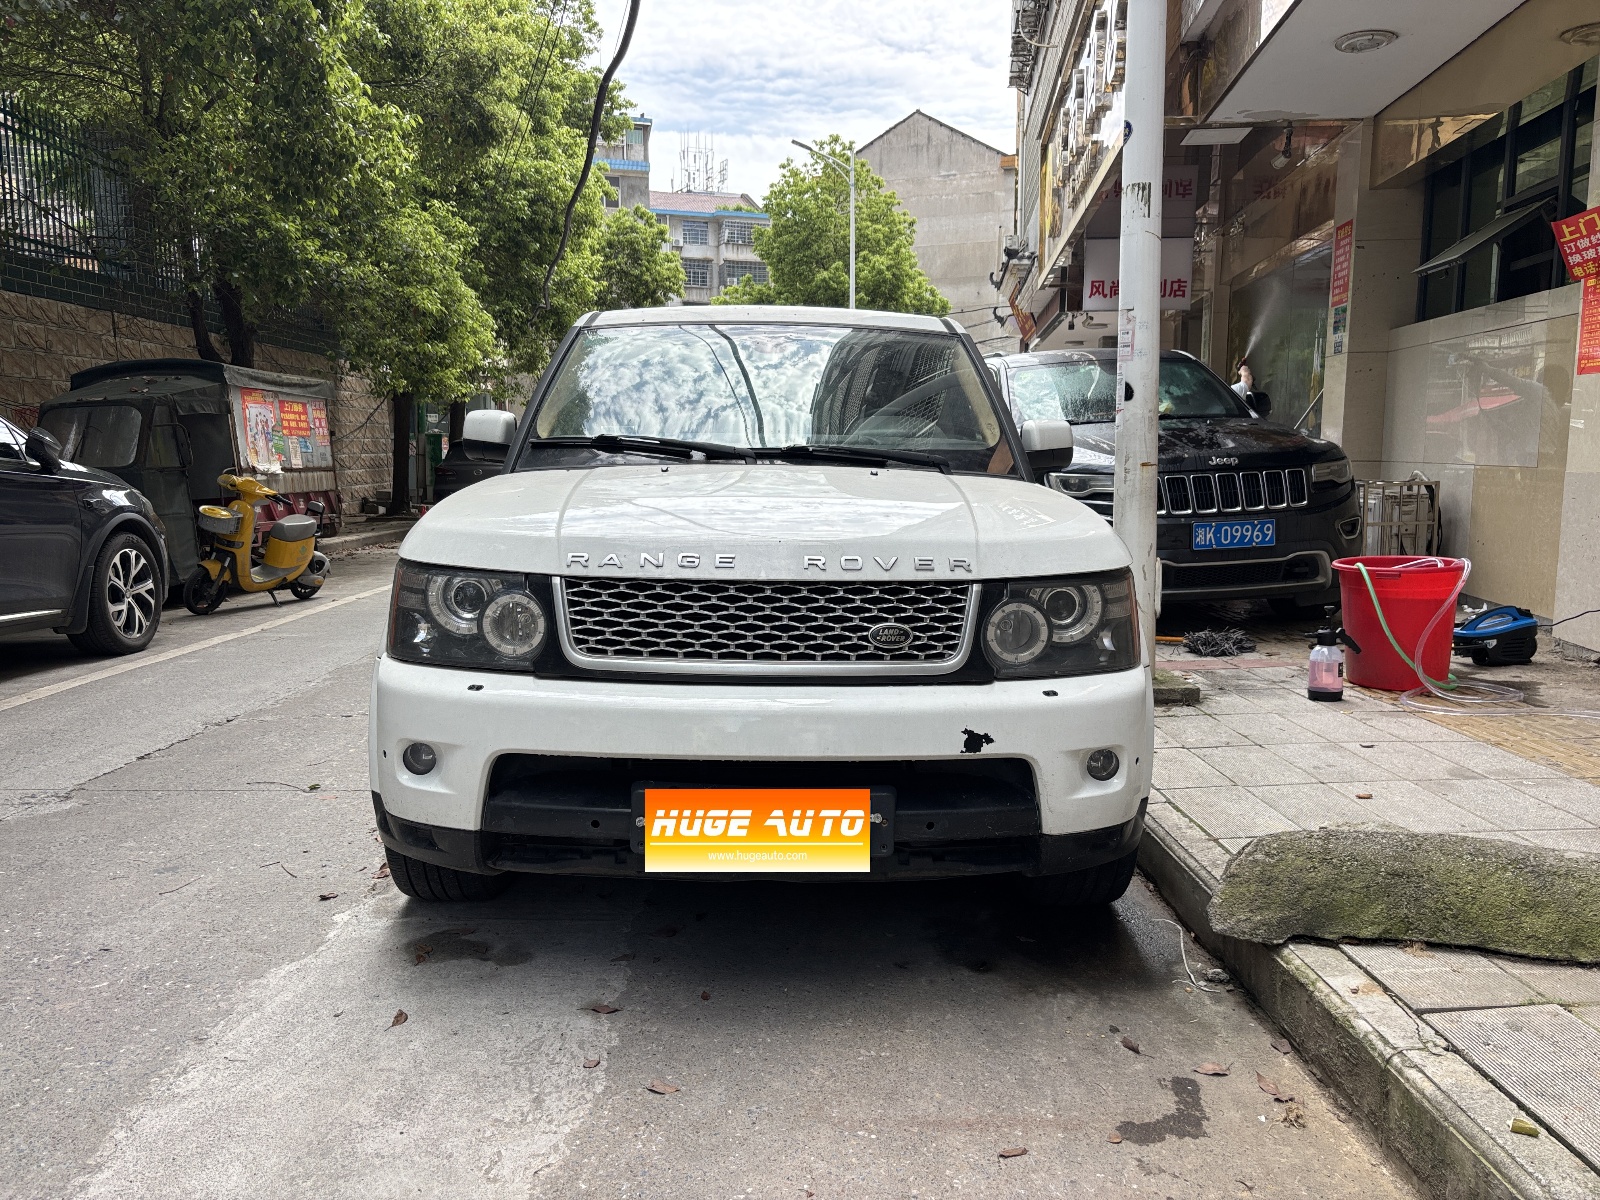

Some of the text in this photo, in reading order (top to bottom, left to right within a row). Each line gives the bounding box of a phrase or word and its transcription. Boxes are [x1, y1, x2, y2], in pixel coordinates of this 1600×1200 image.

[1208, 456, 1239, 466] Jeep
[566, 552, 973, 573] RANGE ROVER
